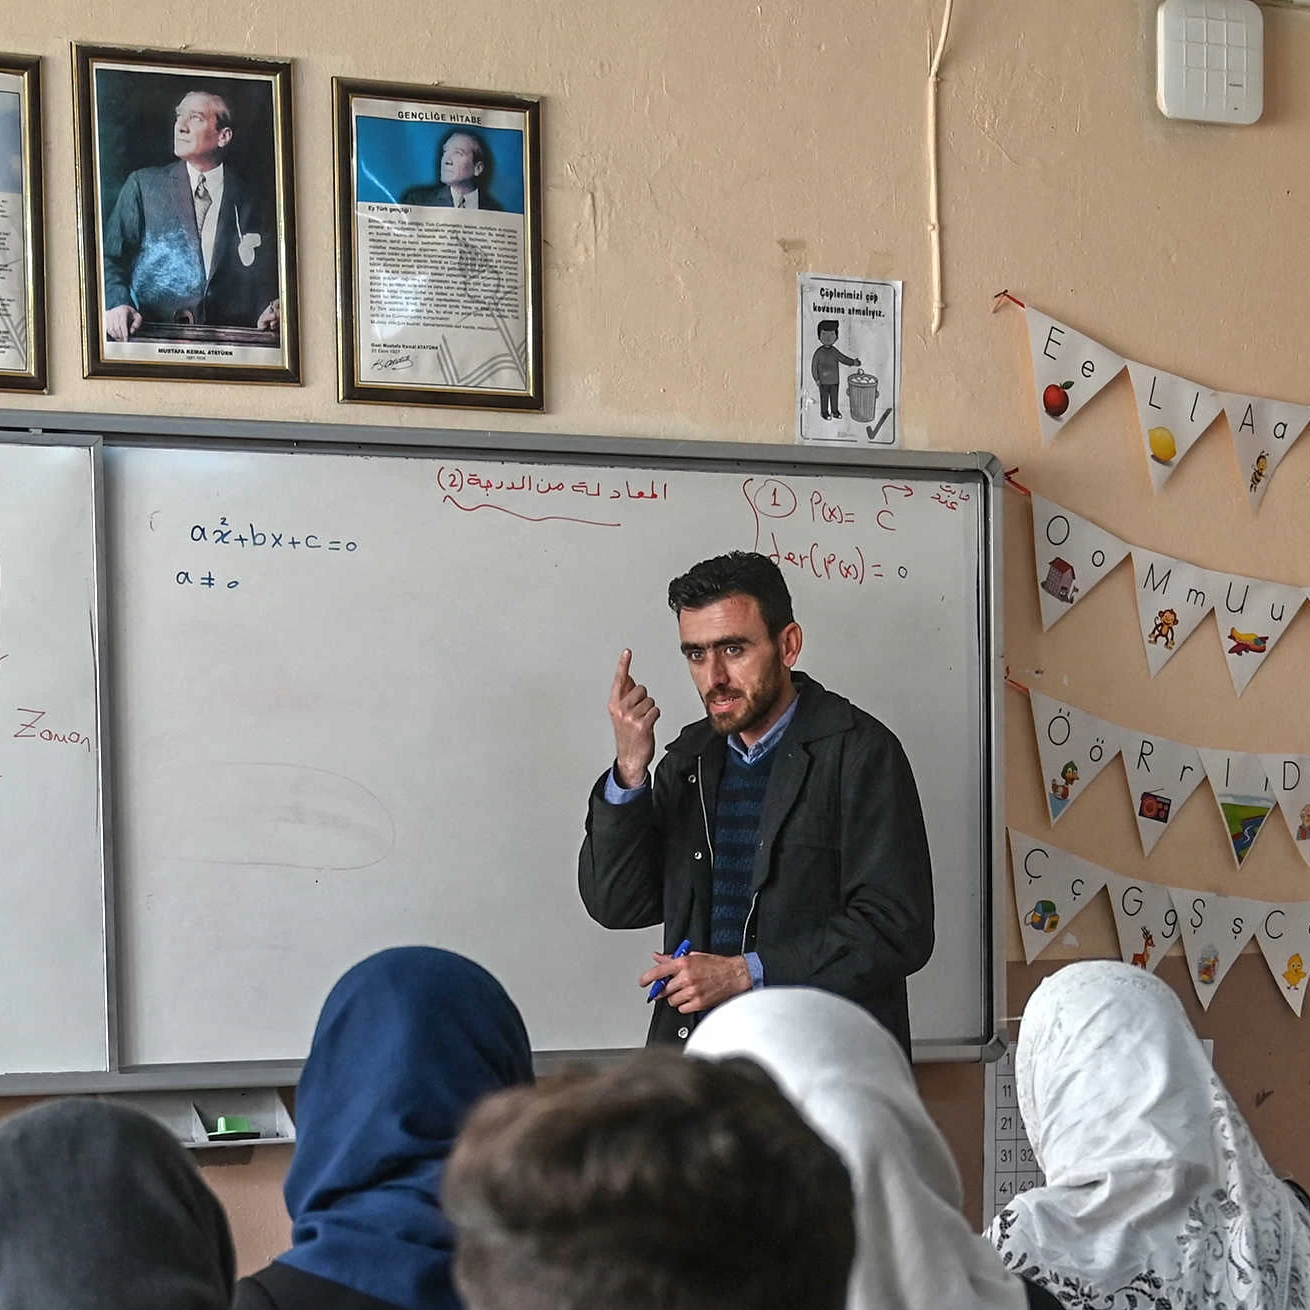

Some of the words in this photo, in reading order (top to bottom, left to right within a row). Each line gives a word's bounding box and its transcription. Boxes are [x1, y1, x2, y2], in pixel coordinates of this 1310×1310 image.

[450, 114, 482, 125] HİTABE
[1044, 326, 1064, 360] E
[1081, 361, 1094, 378] e
[1149, 376, 1161, 409] L
[1190, 392, 1199, 422] l
[1239, 404, 1254, 434] A
[1274, 422, 1287, 439] a
[1047, 515, 1070, 545] O
[1092, 550, 1105, 567] o
[1144, 563, 1171, 595] M
[1187, 588, 1205, 607] m
[1226, 582, 1249, 614] U
[1271, 603, 1284, 621] u
[13, 708, 90, 752] Zaman
[1048, 708, 1070, 745] Ö
[1090, 738, 1104, 762] ö
[1137, 740, 1153, 772] R
[1180, 765, 1193, 781] r
[1283, 761, 1300, 790] D
[1025, 849, 1049, 884] Ç
[1071, 879, 1084, 901] ç
[1122, 886, 1143, 916] G
[1162, 909, 1178, 938] g
[1190, 899, 1205, 934] Ş
[1232, 918, 1243, 940] ş
[1265, 910, 1285, 939] C
[1002, 1085, 1012, 1098] 11
[1000, 1117, 1012, 1130] 21
[1000, 1150, 1012, 1162] 31
[1020, 1150, 1034, 1162] 32
[999, 1182, 1012, 1194] 41
